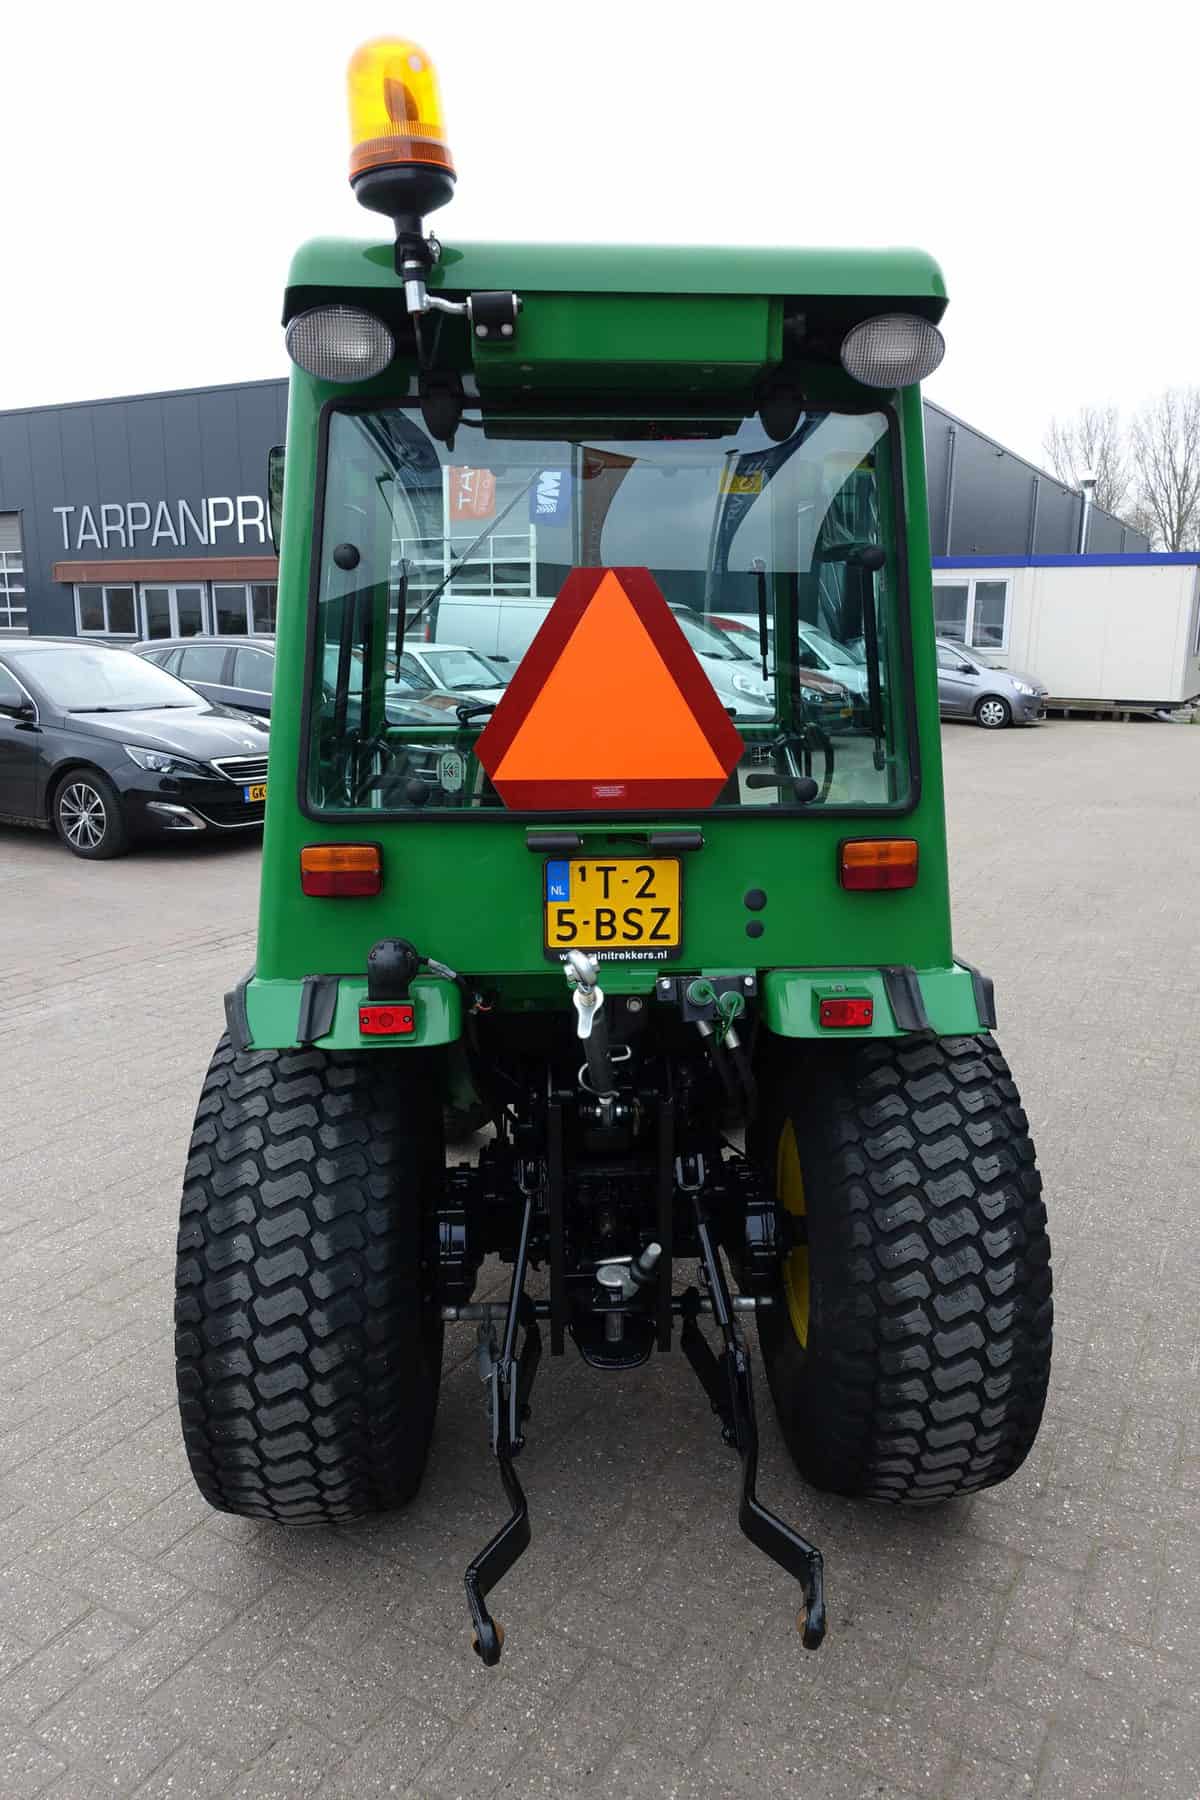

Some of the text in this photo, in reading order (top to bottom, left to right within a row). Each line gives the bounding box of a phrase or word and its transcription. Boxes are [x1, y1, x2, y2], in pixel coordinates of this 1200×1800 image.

[53, 495, 272, 549] TARPANPR
[551, 885, 565, 896] NL
[556, 907, 671, 941] 5-BSZ
